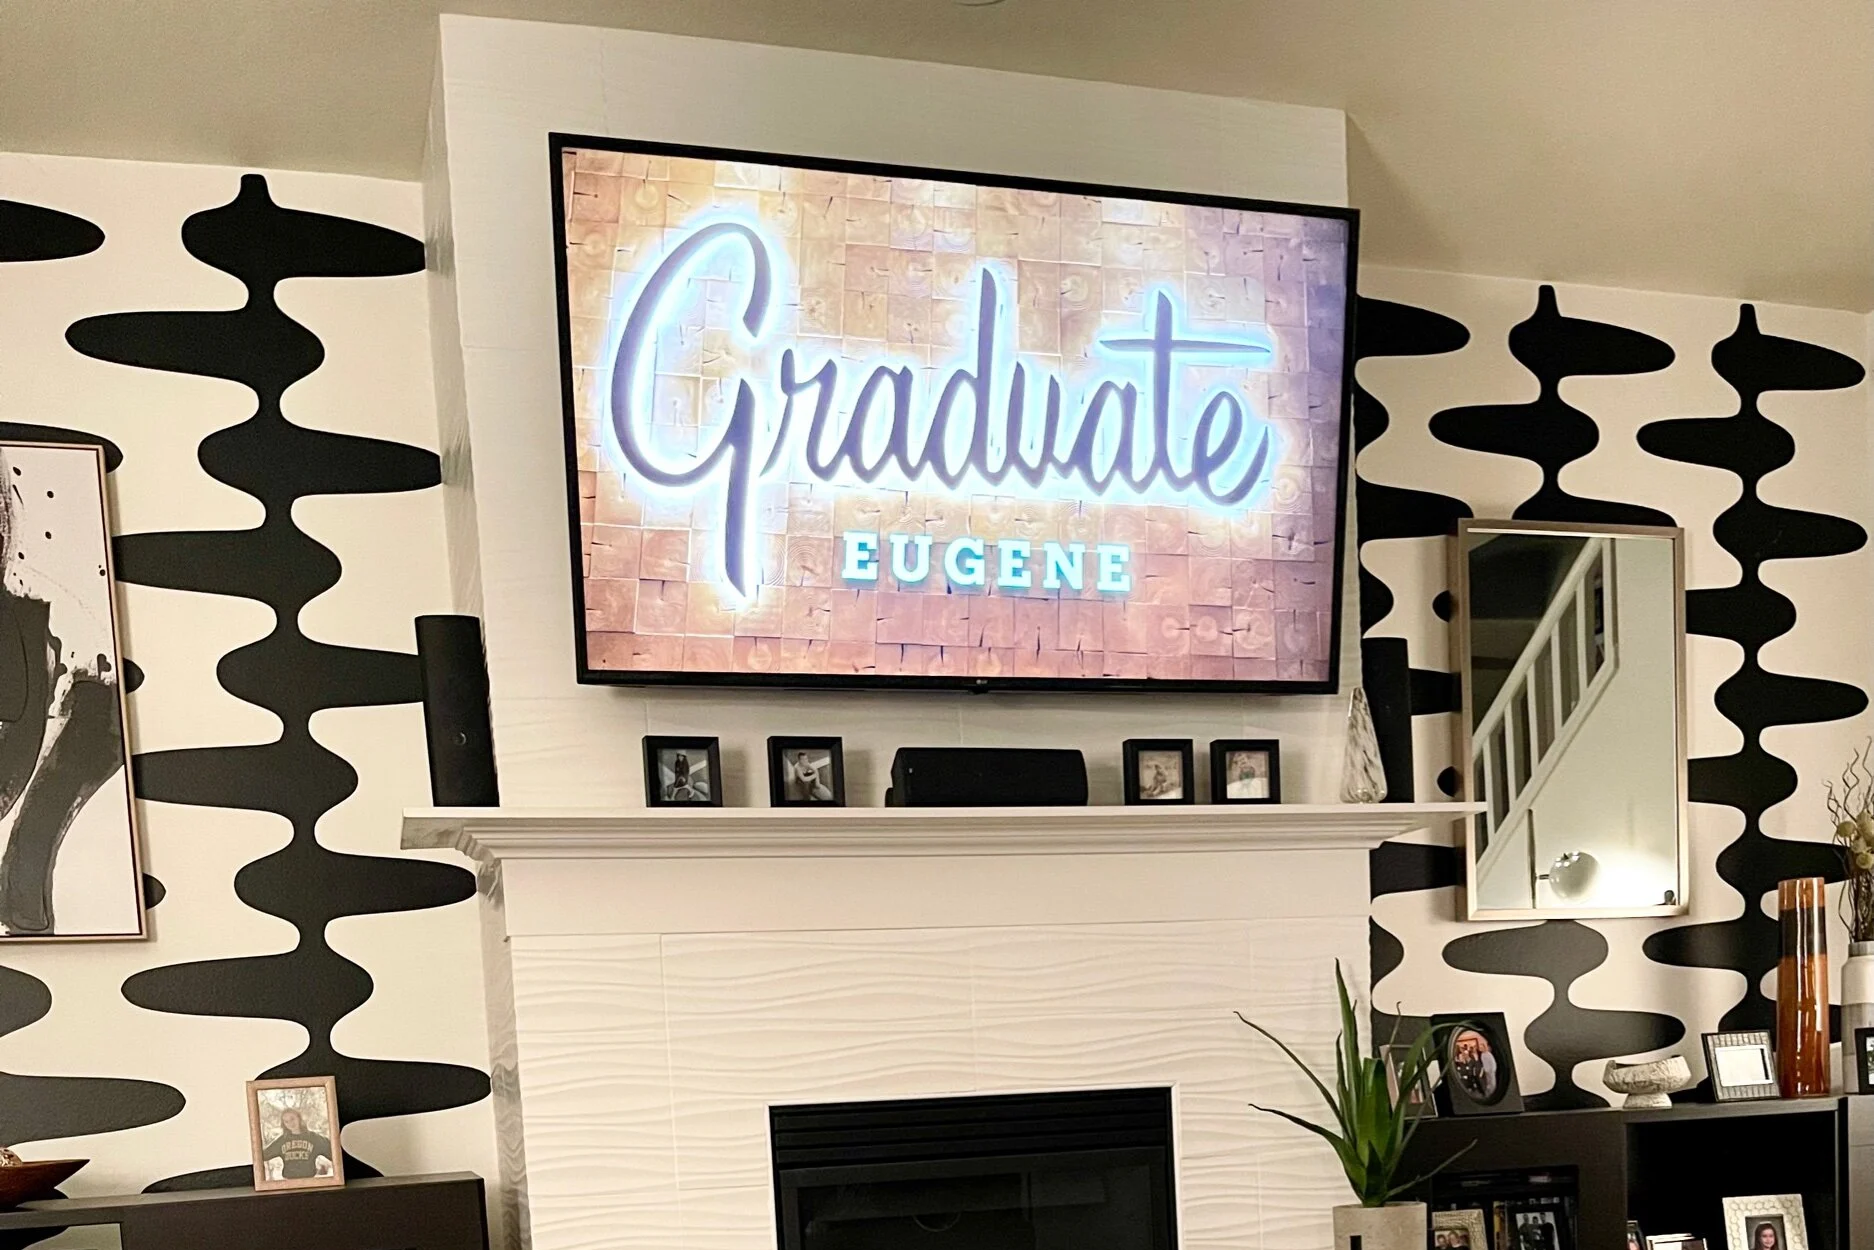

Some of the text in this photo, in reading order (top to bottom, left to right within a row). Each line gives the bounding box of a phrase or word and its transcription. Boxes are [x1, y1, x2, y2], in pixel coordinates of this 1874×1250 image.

[609, 221, 1271, 598] Graduate
[841, 530, 1131, 592] EUGENE
[281, 1139, 314, 1154] OREGON
